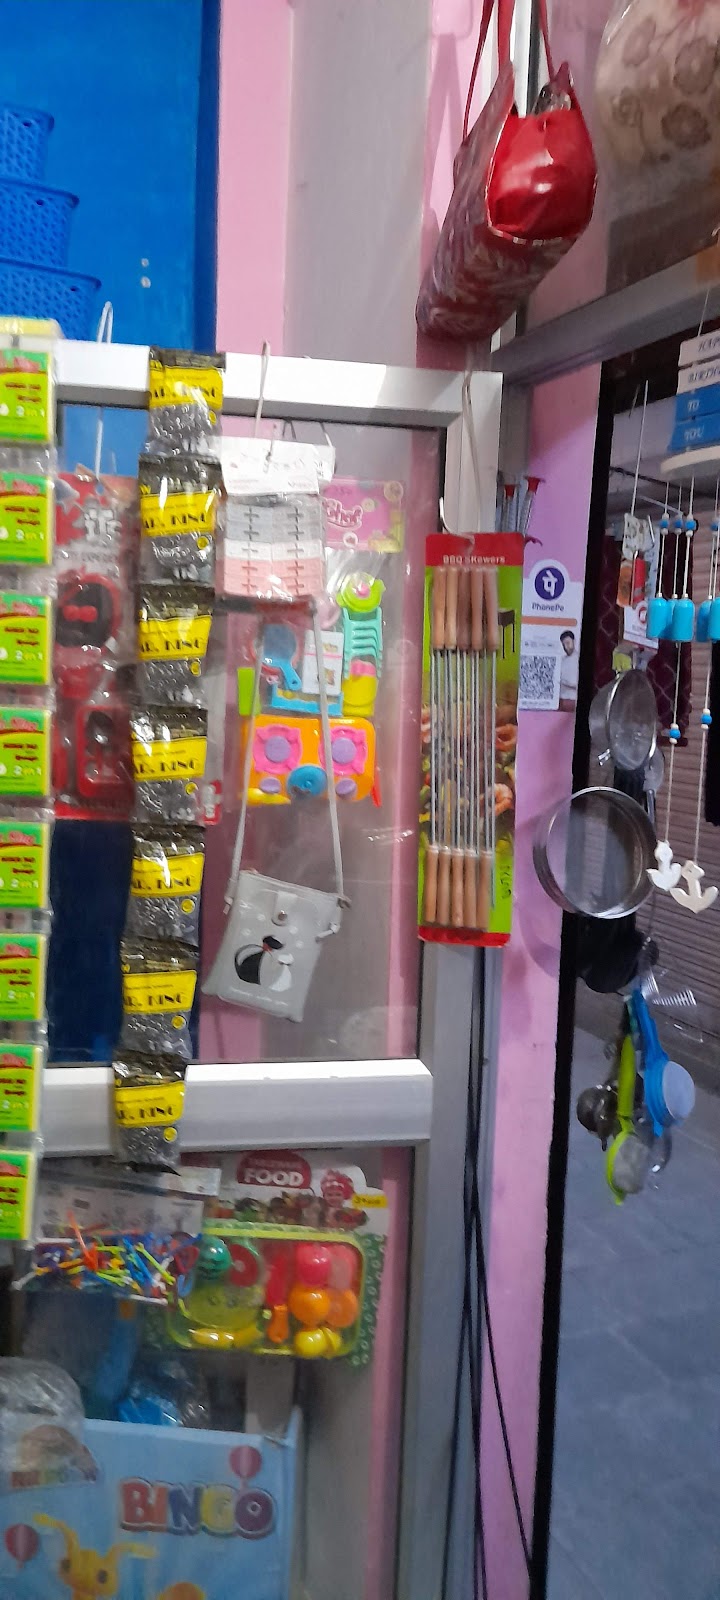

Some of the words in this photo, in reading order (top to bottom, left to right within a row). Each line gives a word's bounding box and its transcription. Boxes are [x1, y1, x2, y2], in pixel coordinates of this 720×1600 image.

[443, 555, 463, 565] BBQ
[532, 602, 565, 612] PhonePe
[244, 1168, 304, 1187] FOOD
[120, 1477, 277, 1540] BINGO
